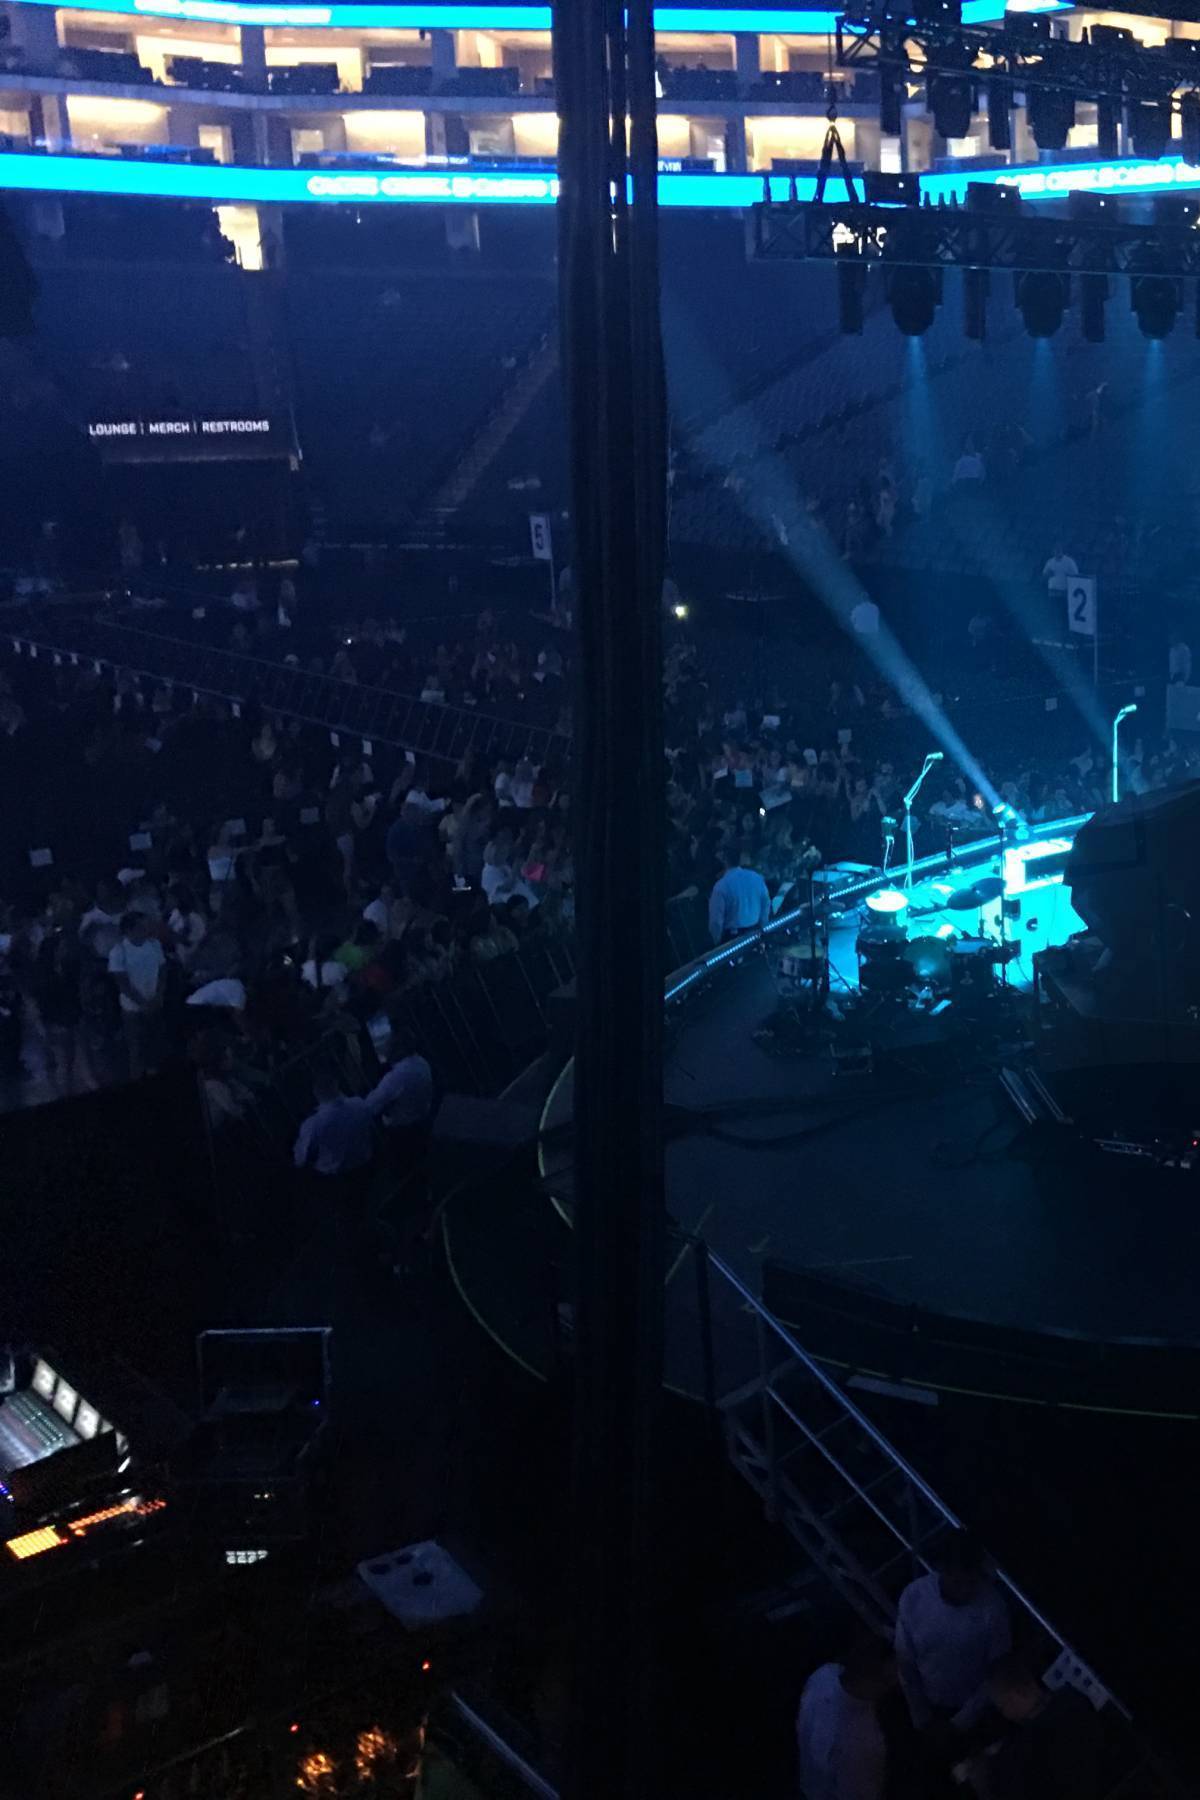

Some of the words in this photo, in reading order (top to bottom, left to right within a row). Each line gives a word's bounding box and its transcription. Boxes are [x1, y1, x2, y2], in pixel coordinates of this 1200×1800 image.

[88, 422, 137, 436] LOUNGE
[149, 421, 190, 434] MERCH
[202, 420, 270, 433] RESTROOMS
[1072, 587, 1087, 622] 2
